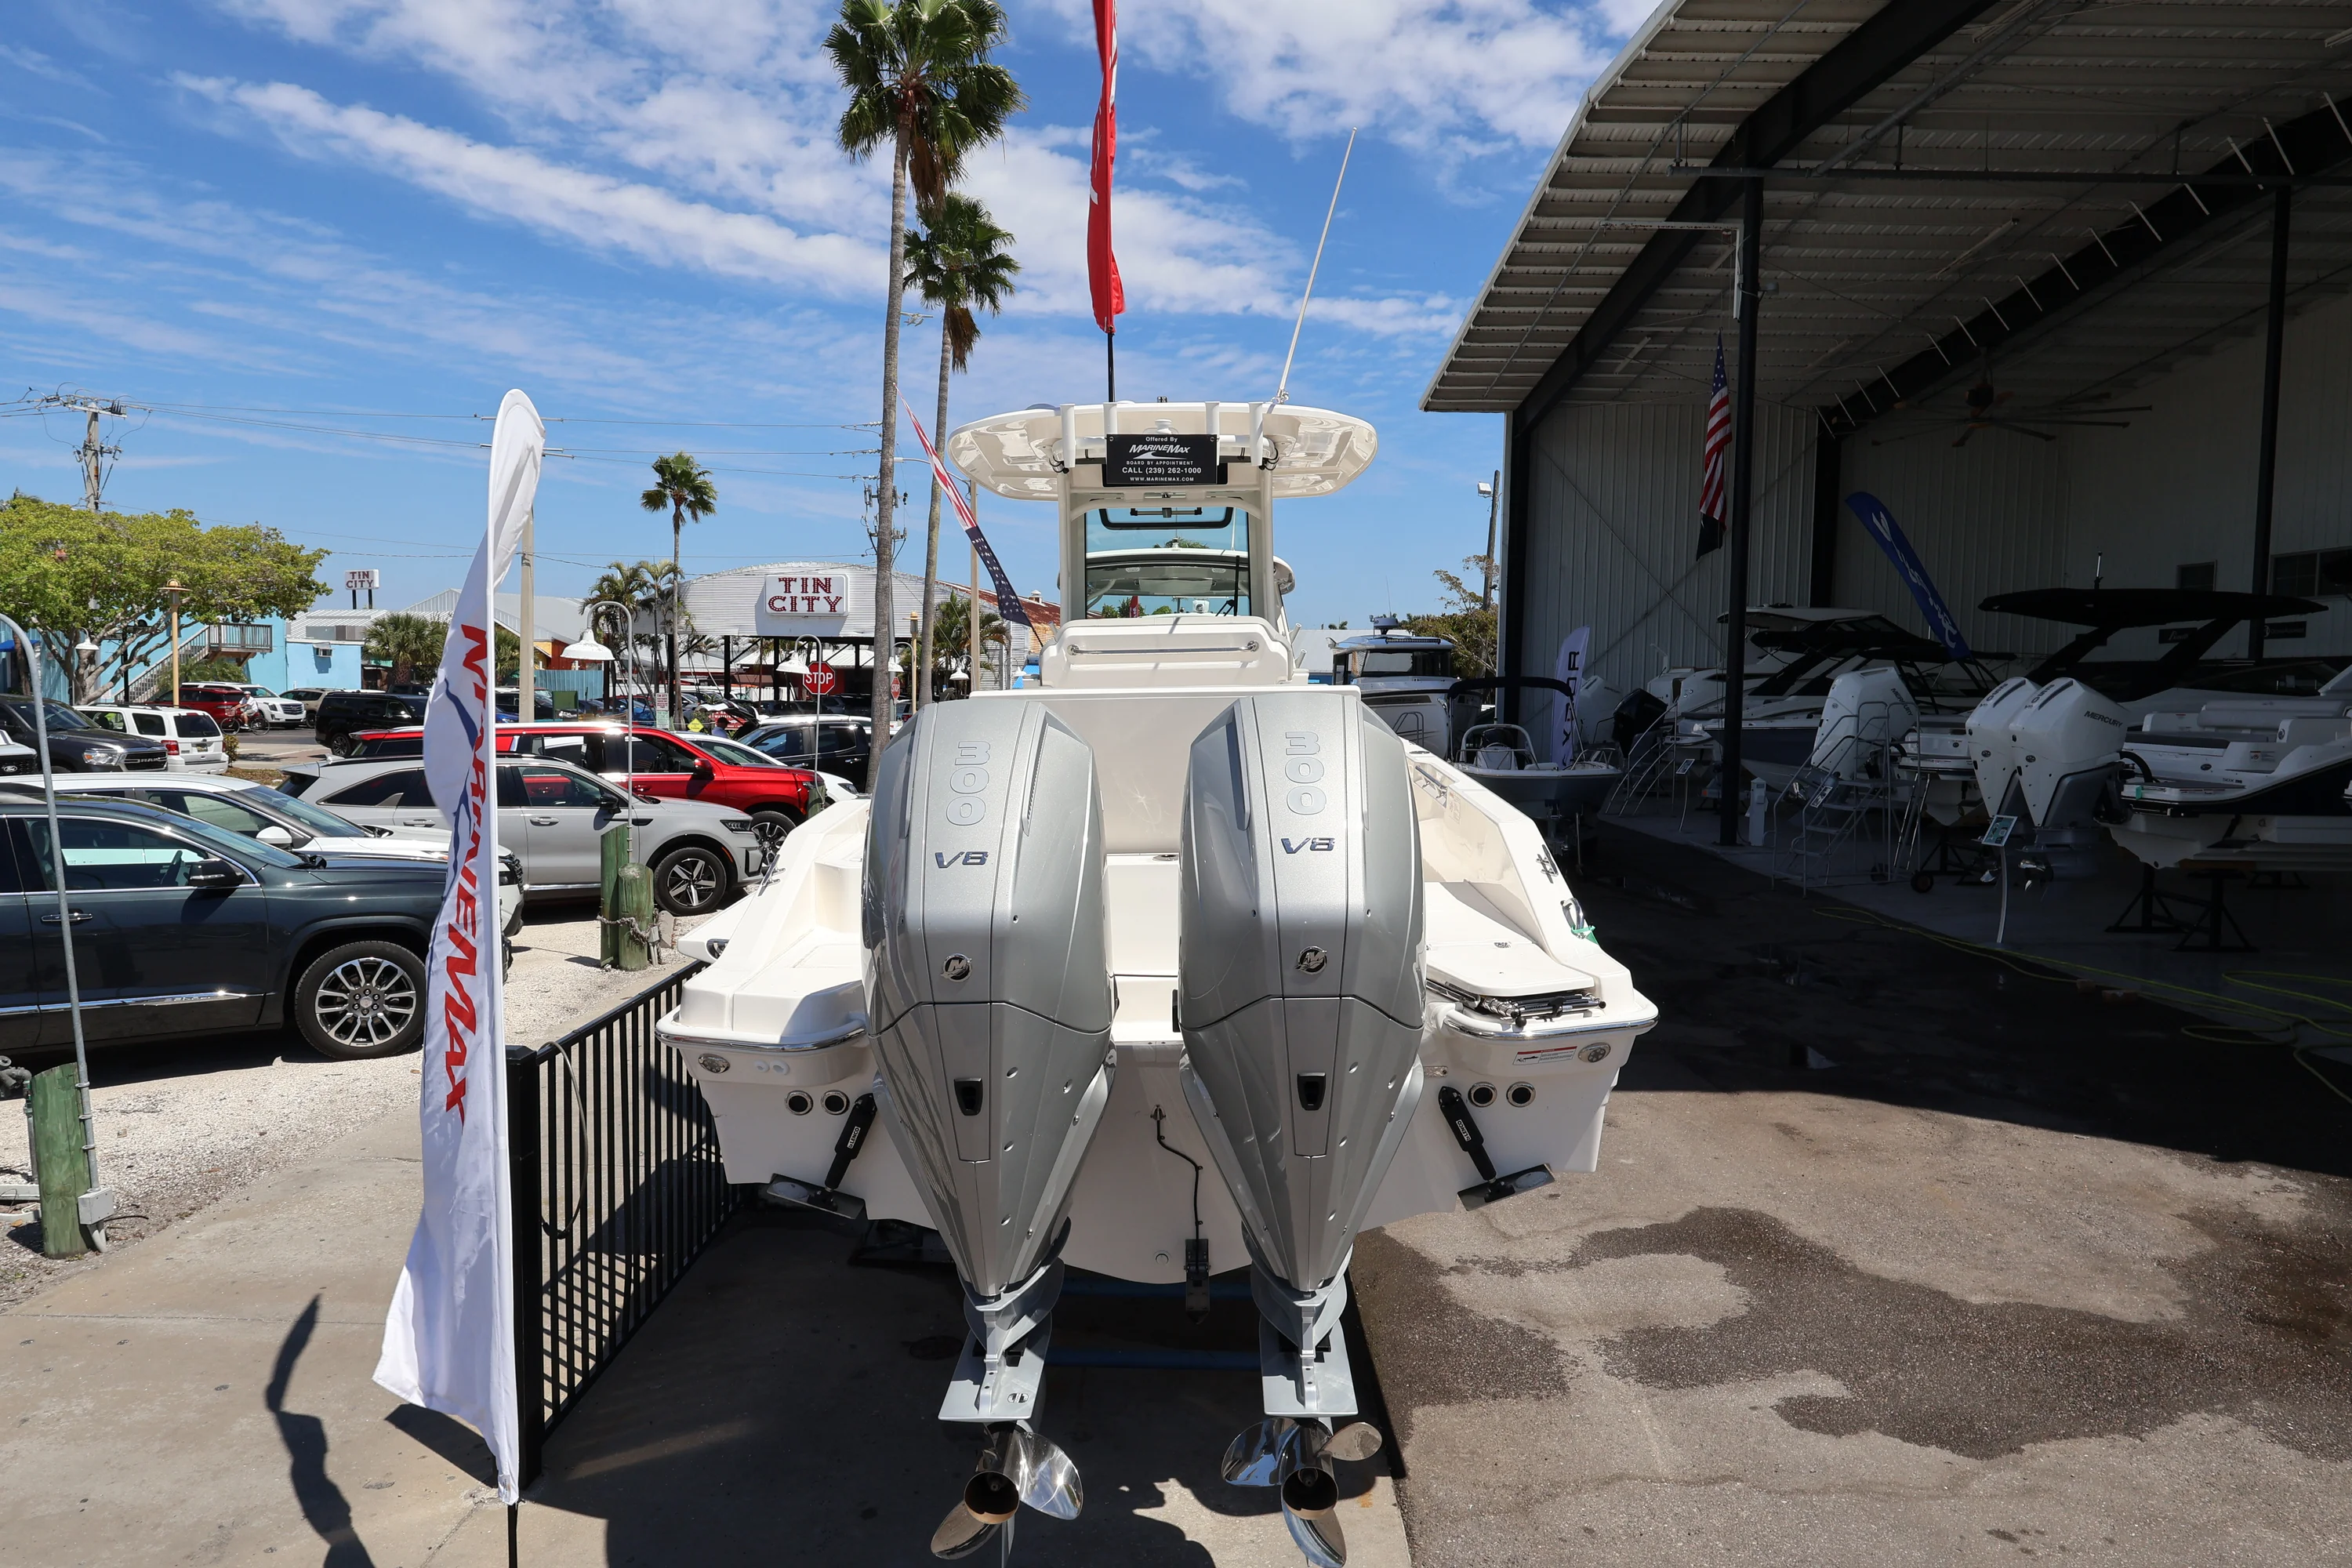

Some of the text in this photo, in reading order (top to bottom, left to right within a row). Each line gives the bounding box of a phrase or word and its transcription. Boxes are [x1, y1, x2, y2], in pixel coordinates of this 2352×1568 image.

[346, 579, 374, 588] CITY
[350, 571, 369, 579] TIN
[779, 577, 832, 593] TIN
[768, 596, 843, 612] CITY
[805, 672, 833, 684] STOP
[891, 684, 900, 692] STOP
[2084, 710, 2123, 728] MERCURY
[1284, 731, 1327, 815] 300
[946, 740, 990, 826] 300
[1281, 837, 1335, 854] V8
[935, 851, 989, 869] V8
[848, 1127, 859, 1144] LENCO
[1457, 1120, 1468, 1137] LENCO
